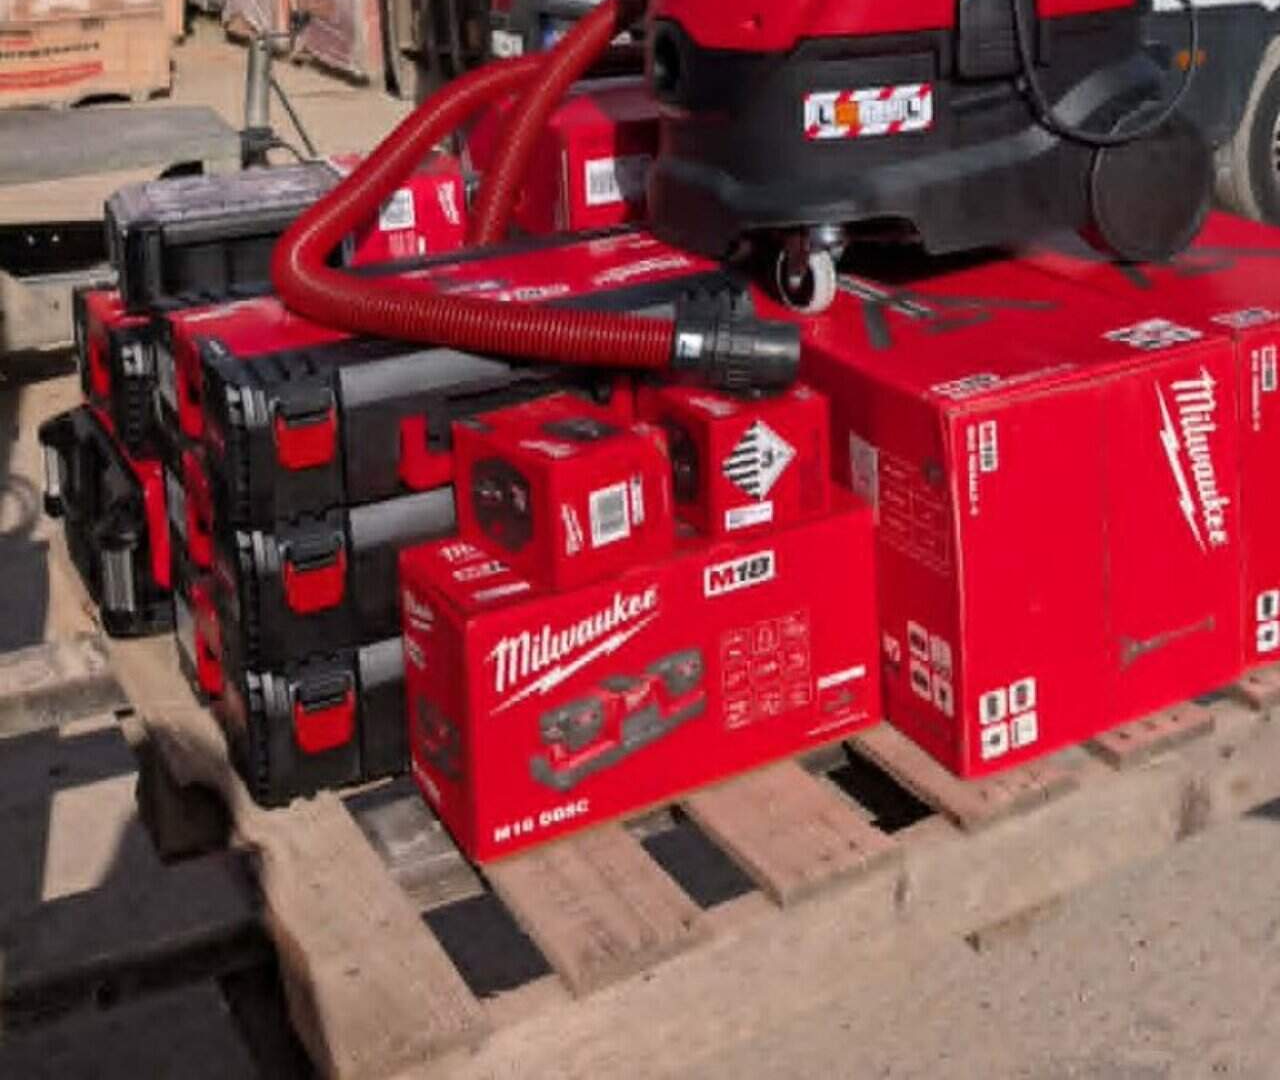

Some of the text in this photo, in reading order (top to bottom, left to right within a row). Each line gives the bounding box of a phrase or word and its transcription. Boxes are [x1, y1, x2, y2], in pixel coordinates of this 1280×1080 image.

[1171, 366, 1229, 547] Milwaukee
[709, 556, 771, 591] M18
[483, 583, 661, 692] Milwaukee
